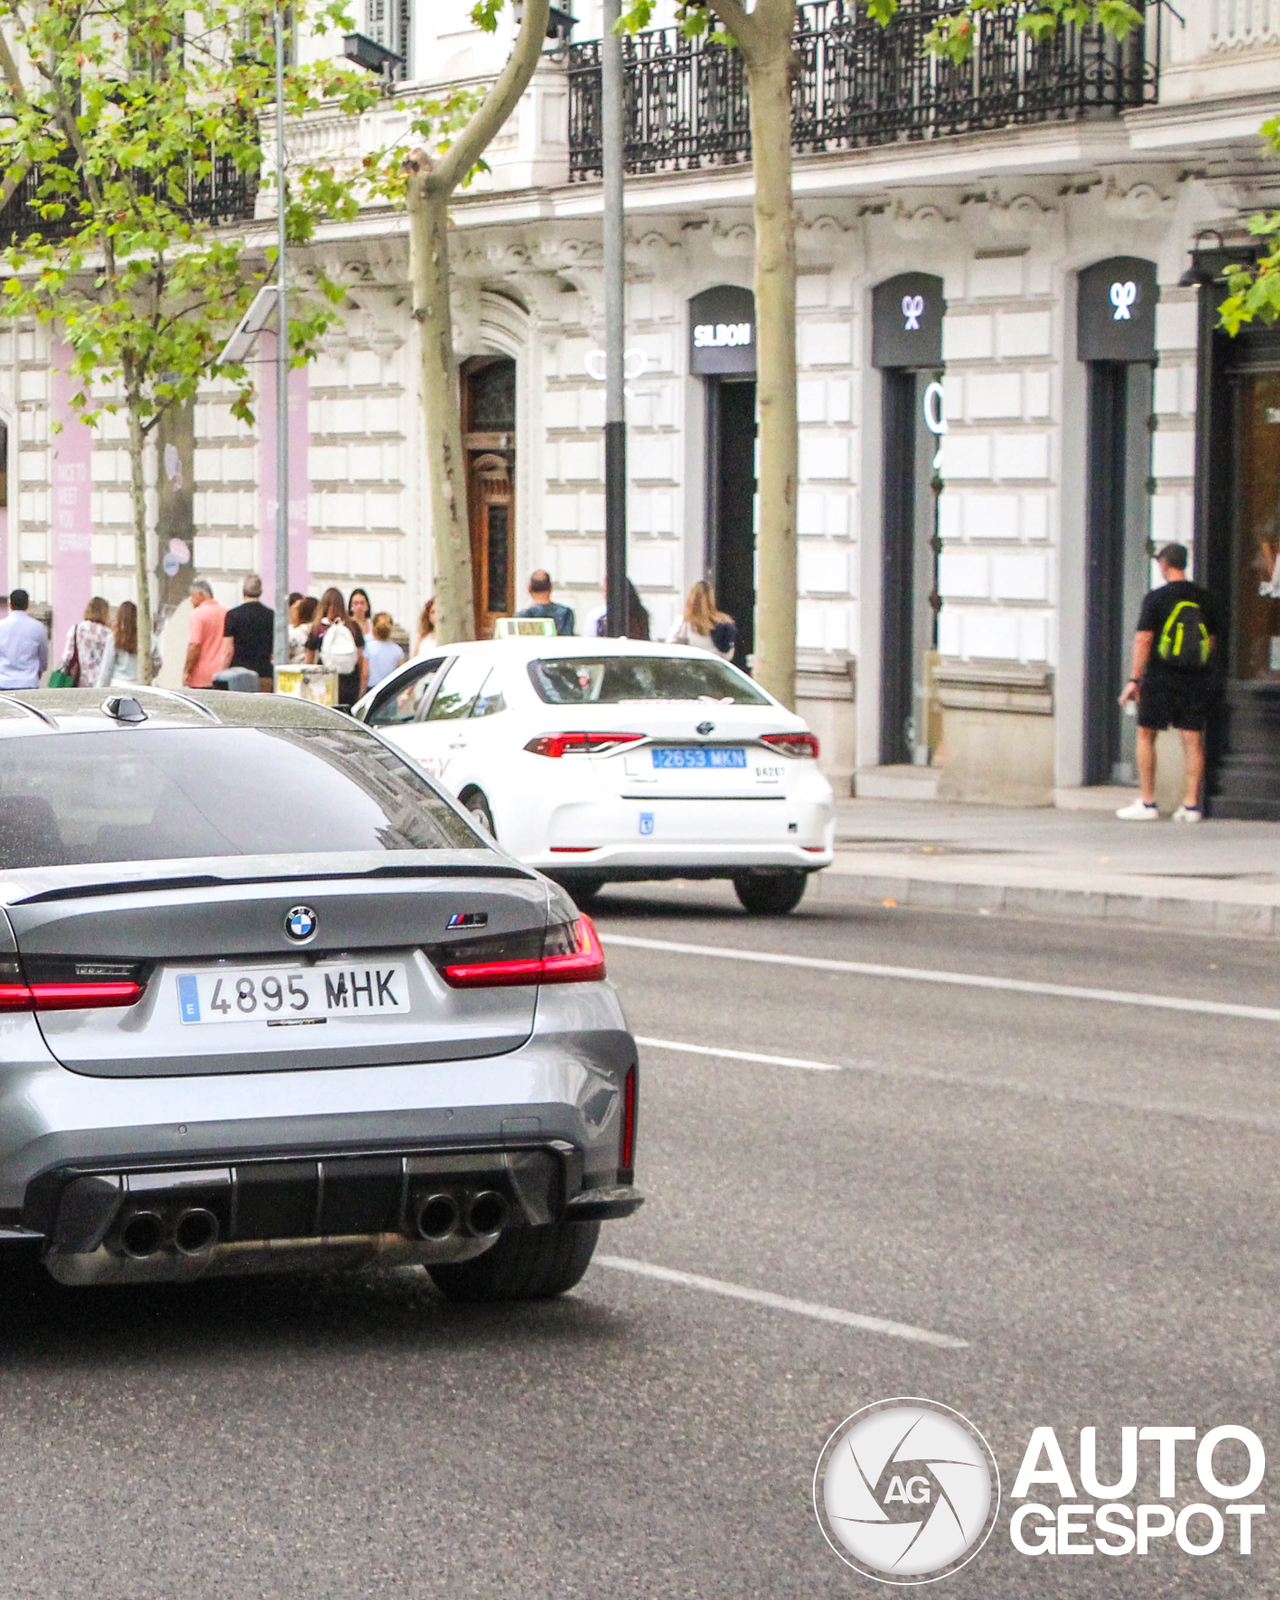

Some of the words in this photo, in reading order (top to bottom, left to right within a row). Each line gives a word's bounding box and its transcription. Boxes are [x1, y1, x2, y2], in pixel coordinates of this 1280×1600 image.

[663, 750, 707, 767] 2653
[210, 975, 310, 1015] 4895
[324, 970, 399, 1009] MHK
